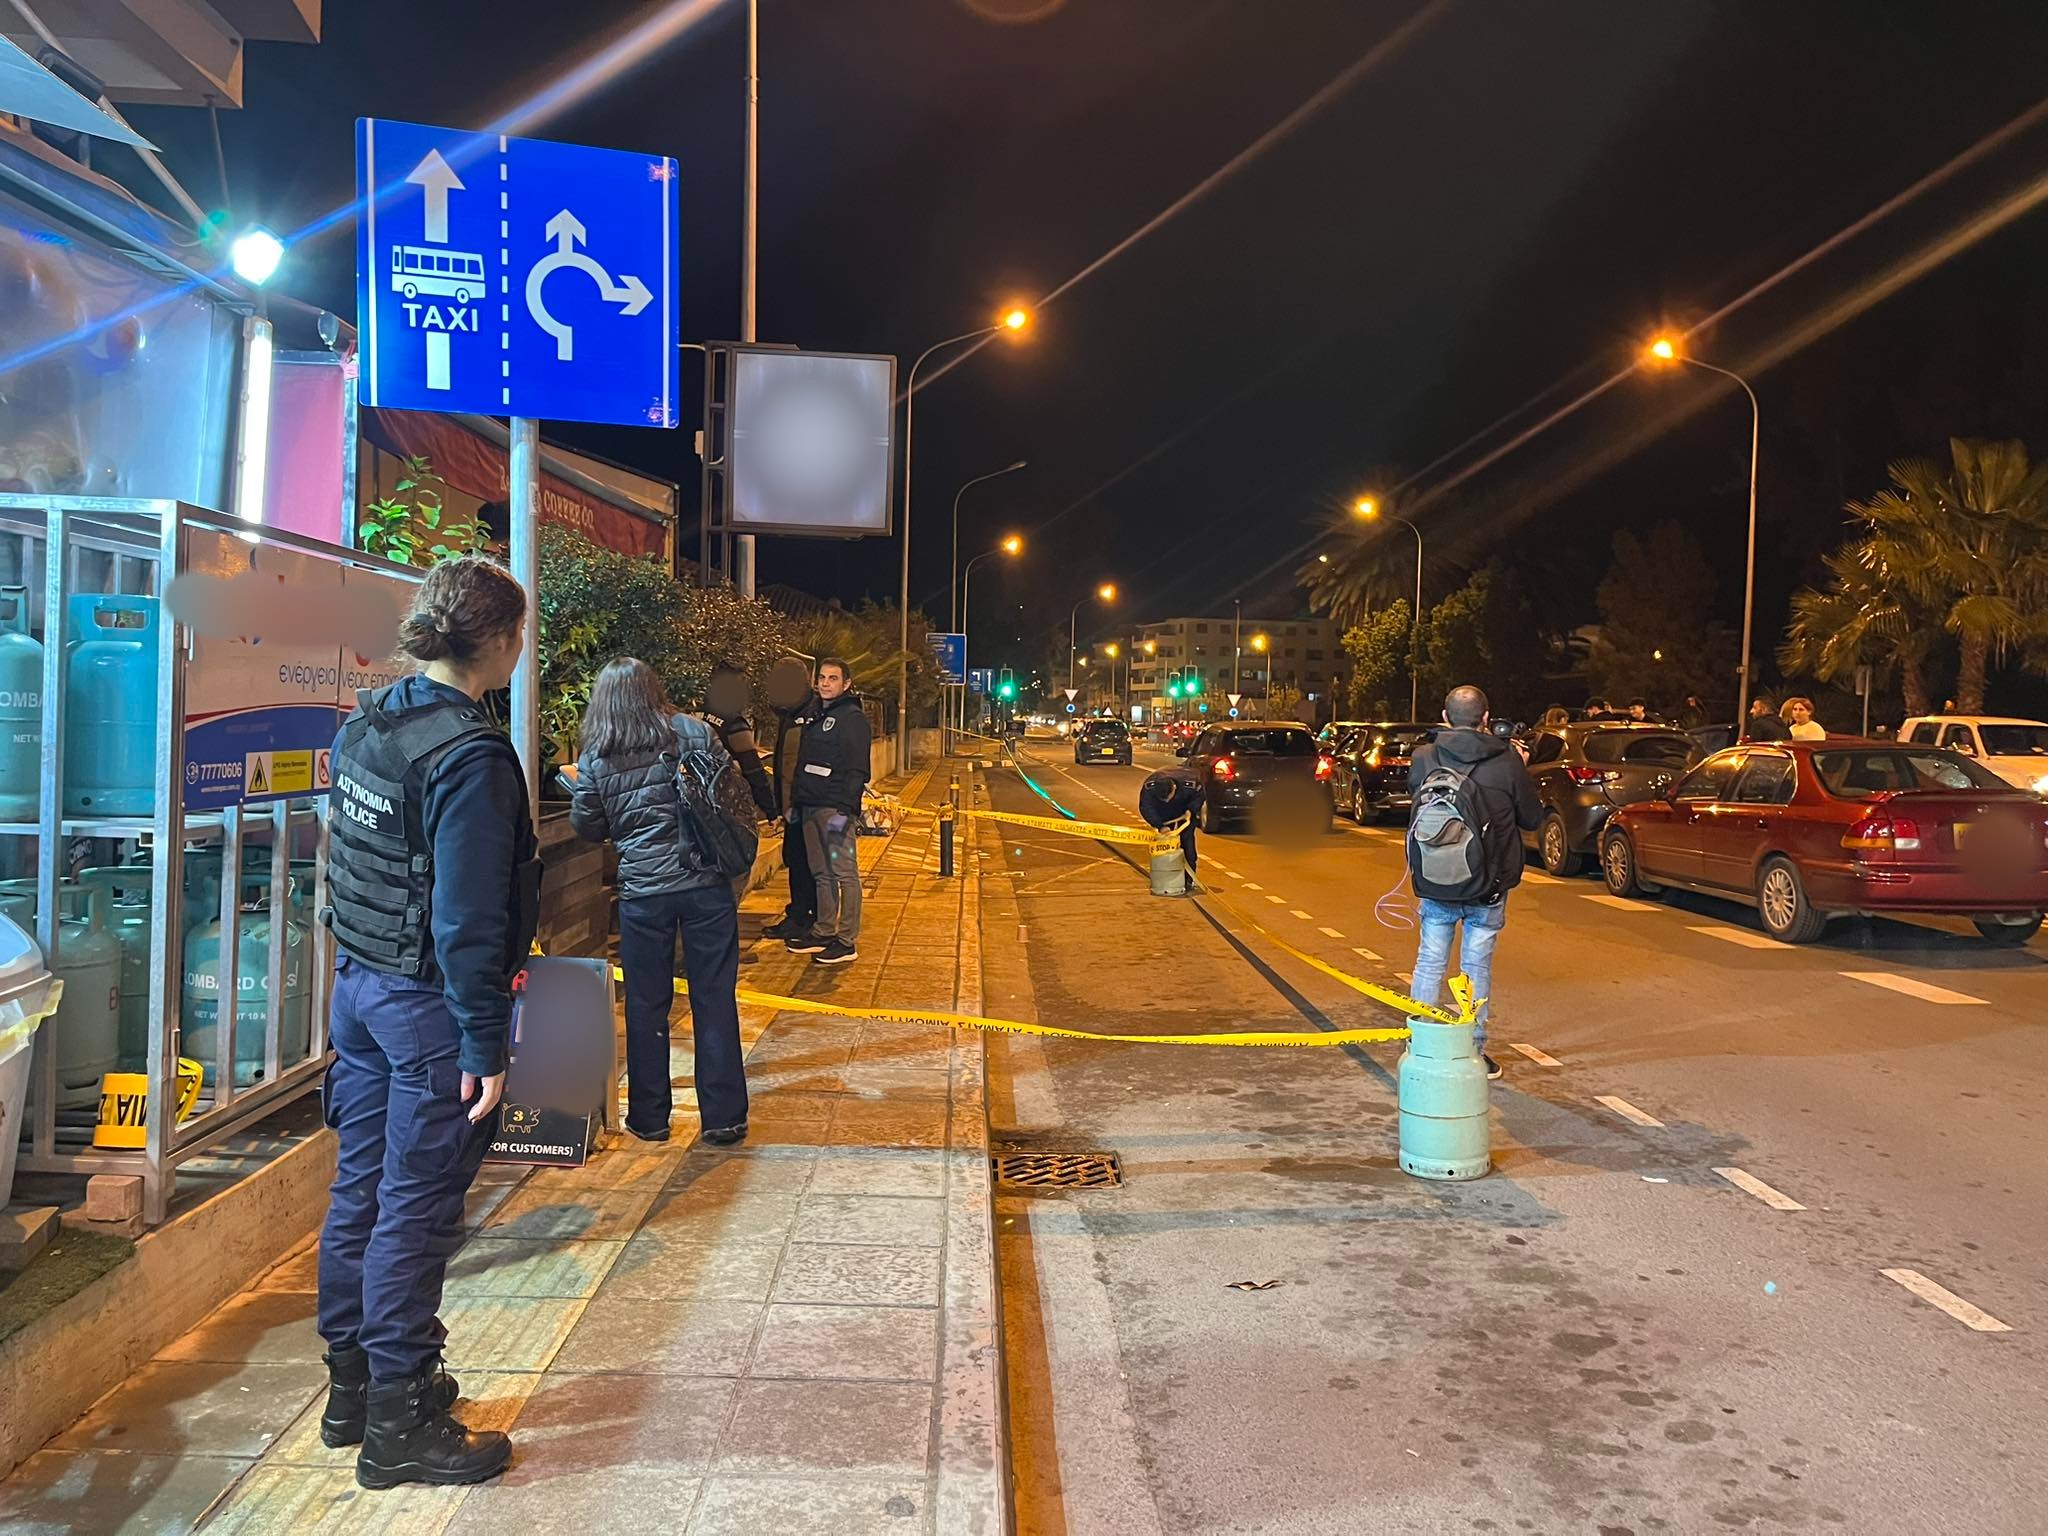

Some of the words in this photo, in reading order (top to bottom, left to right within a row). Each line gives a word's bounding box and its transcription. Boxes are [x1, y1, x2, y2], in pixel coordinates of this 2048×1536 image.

[402, 303, 478, 332] TAXI
[200, 762, 243, 781] 77770606
[336, 773, 394, 815] ΑΣΤΥΝΟΜΙΑ
[342, 797, 378, 830] POLICE
[512, 1110, 524, 1122] 3
[509, 1144, 574, 1157] CUSTOMERS)
